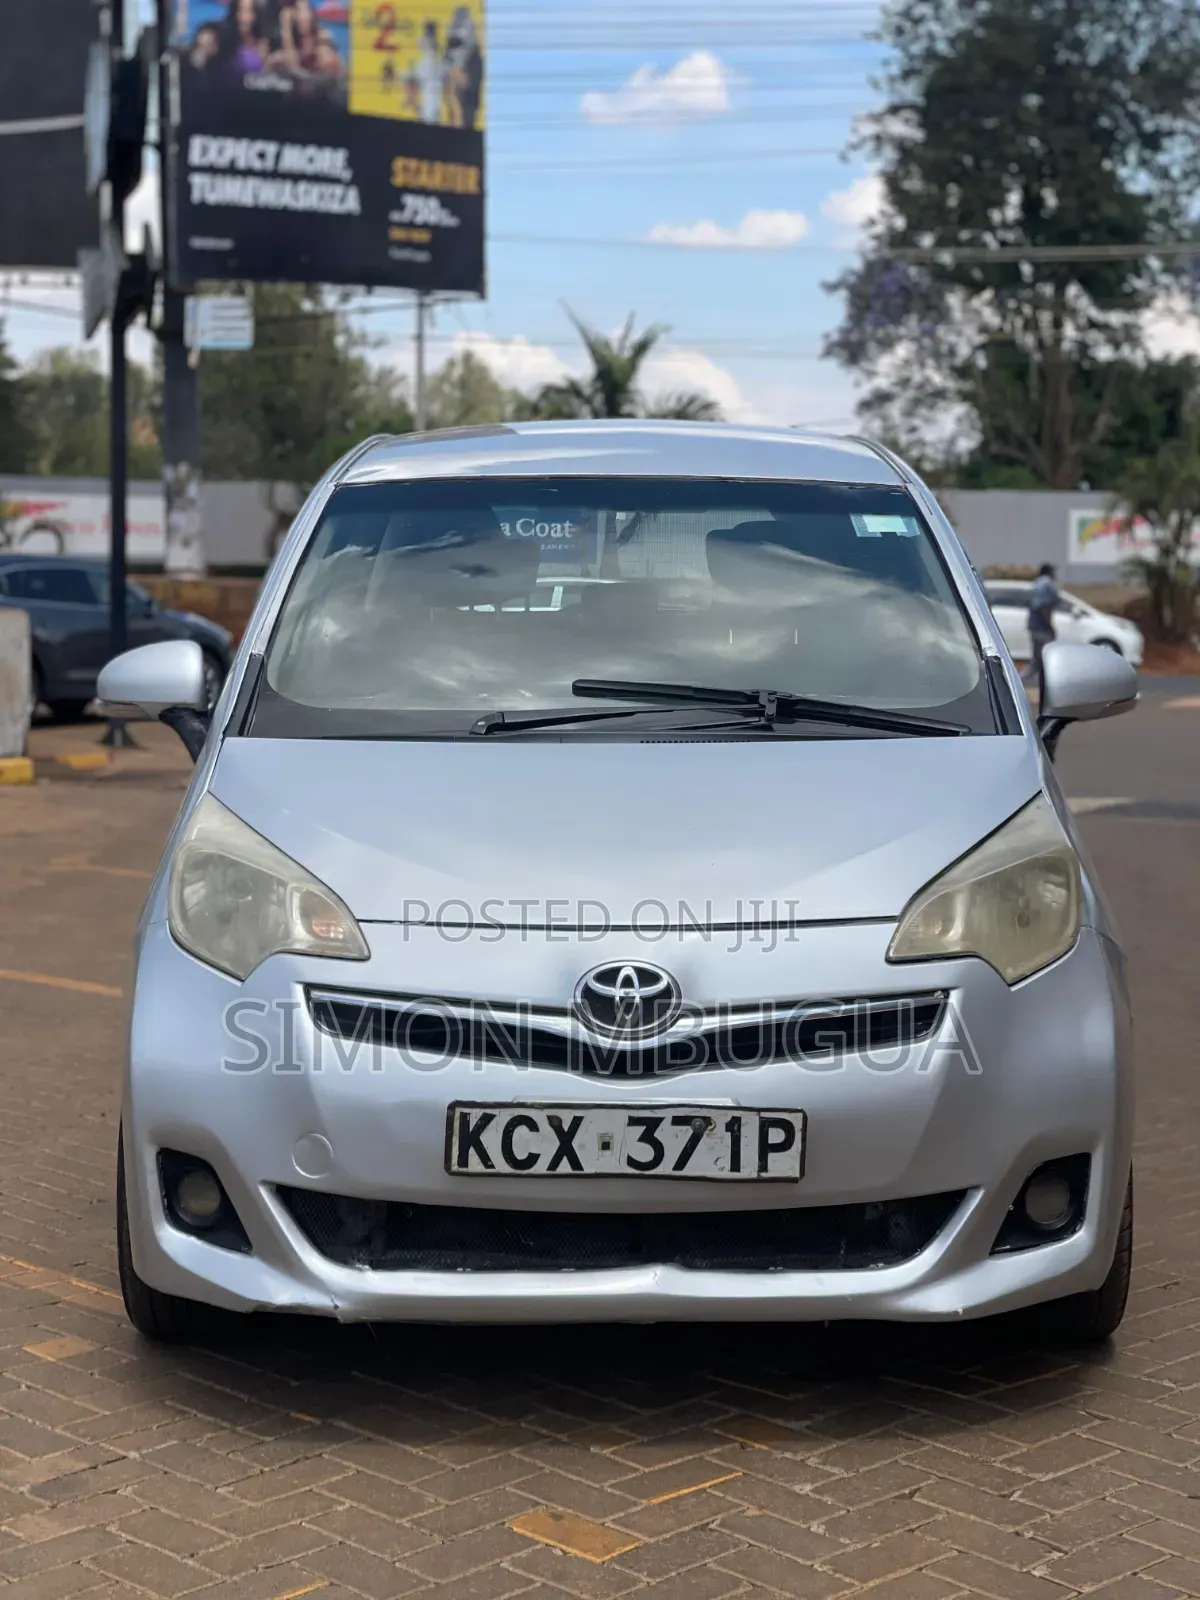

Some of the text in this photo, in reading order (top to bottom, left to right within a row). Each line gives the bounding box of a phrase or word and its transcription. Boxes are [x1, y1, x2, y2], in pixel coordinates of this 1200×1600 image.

[187, 133, 280, 173] EXPECT
[516, 518, 573, 538] Coat
[456, 1111, 796, 1174] KCX 371P
